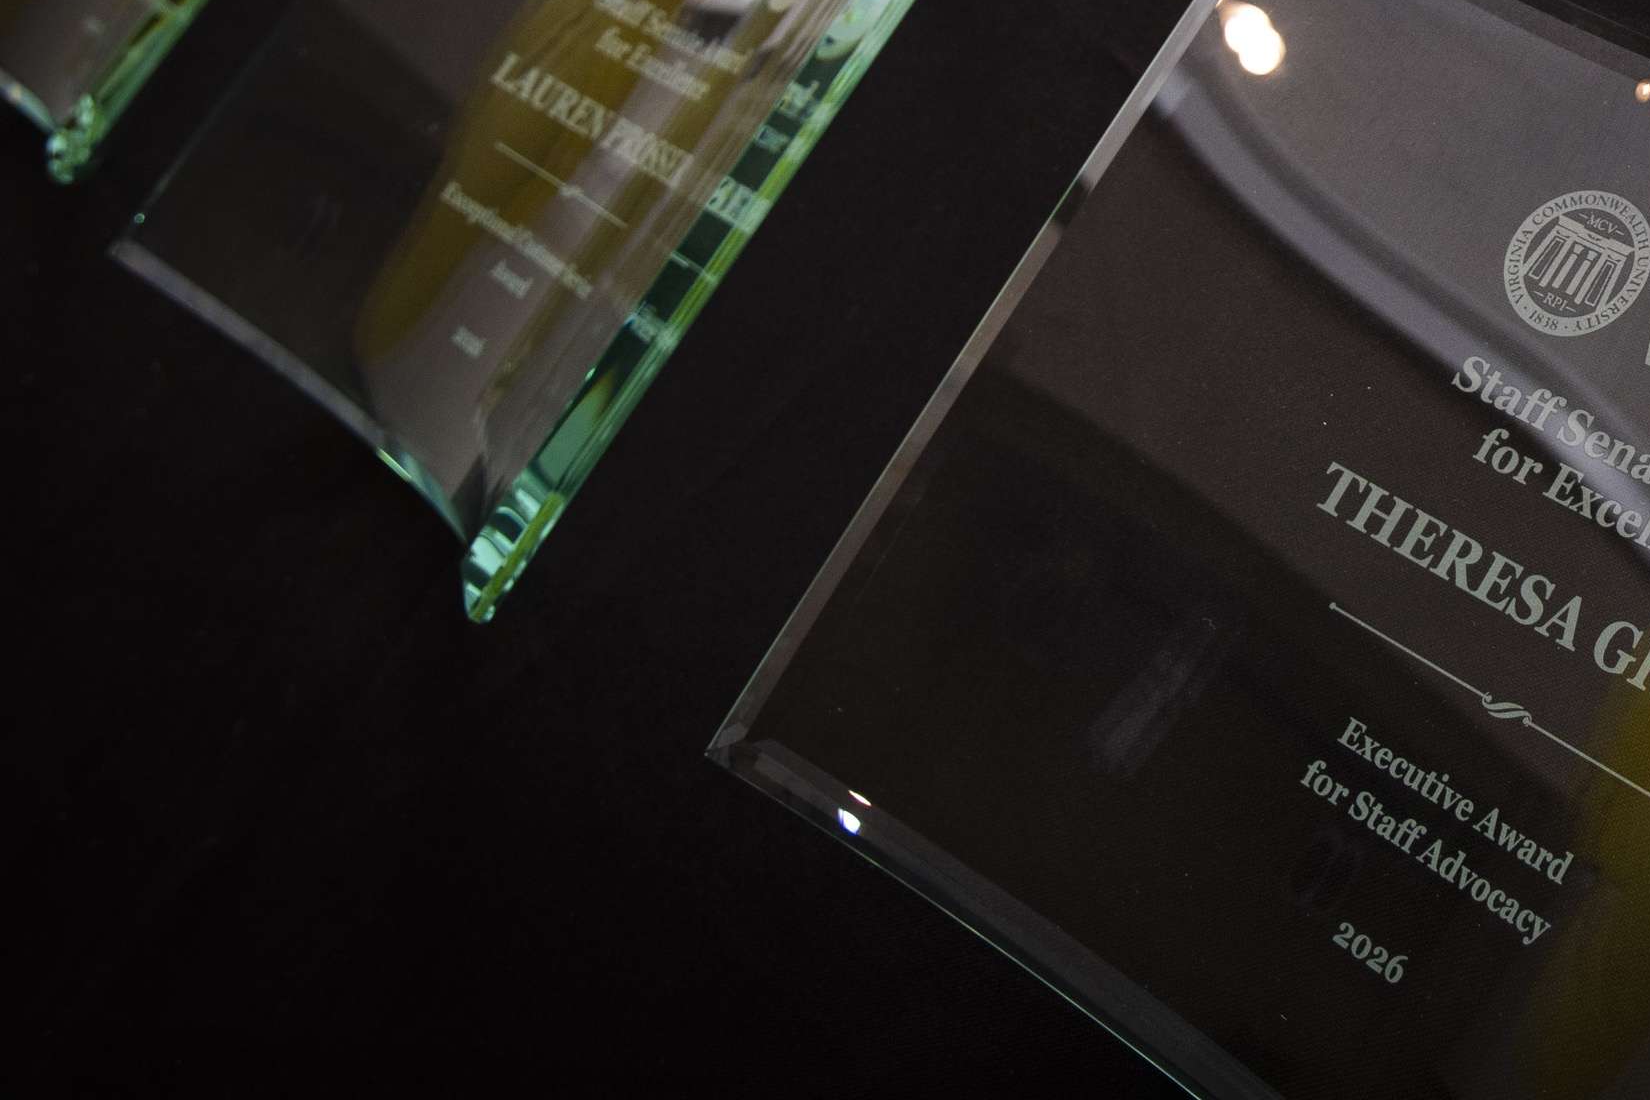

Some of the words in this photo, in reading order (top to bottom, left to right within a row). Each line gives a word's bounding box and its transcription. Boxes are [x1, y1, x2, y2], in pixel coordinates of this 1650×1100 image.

[1532, 194, 1650, 251] COMMONWEALTH
[1508, 228, 1533, 304] VIRGINIA
[1573, 256, 1650, 332] UNIVERSITY
[1527, 310, 1559, 331] 1838
[1451, 355, 1568, 422] Staff
[1472, 427, 1543, 486] for
[1316, 462, 1585, 651] THERESA
[1336, 716, 1475, 822] Executive
[1472, 806, 1576, 886] Award
[1299, 758, 1349, 807] for
[1347, 790, 1428, 855] Staff
[1415, 832, 1552, 946] Advocacy
[1332, 921, 1410, 985] 2026
